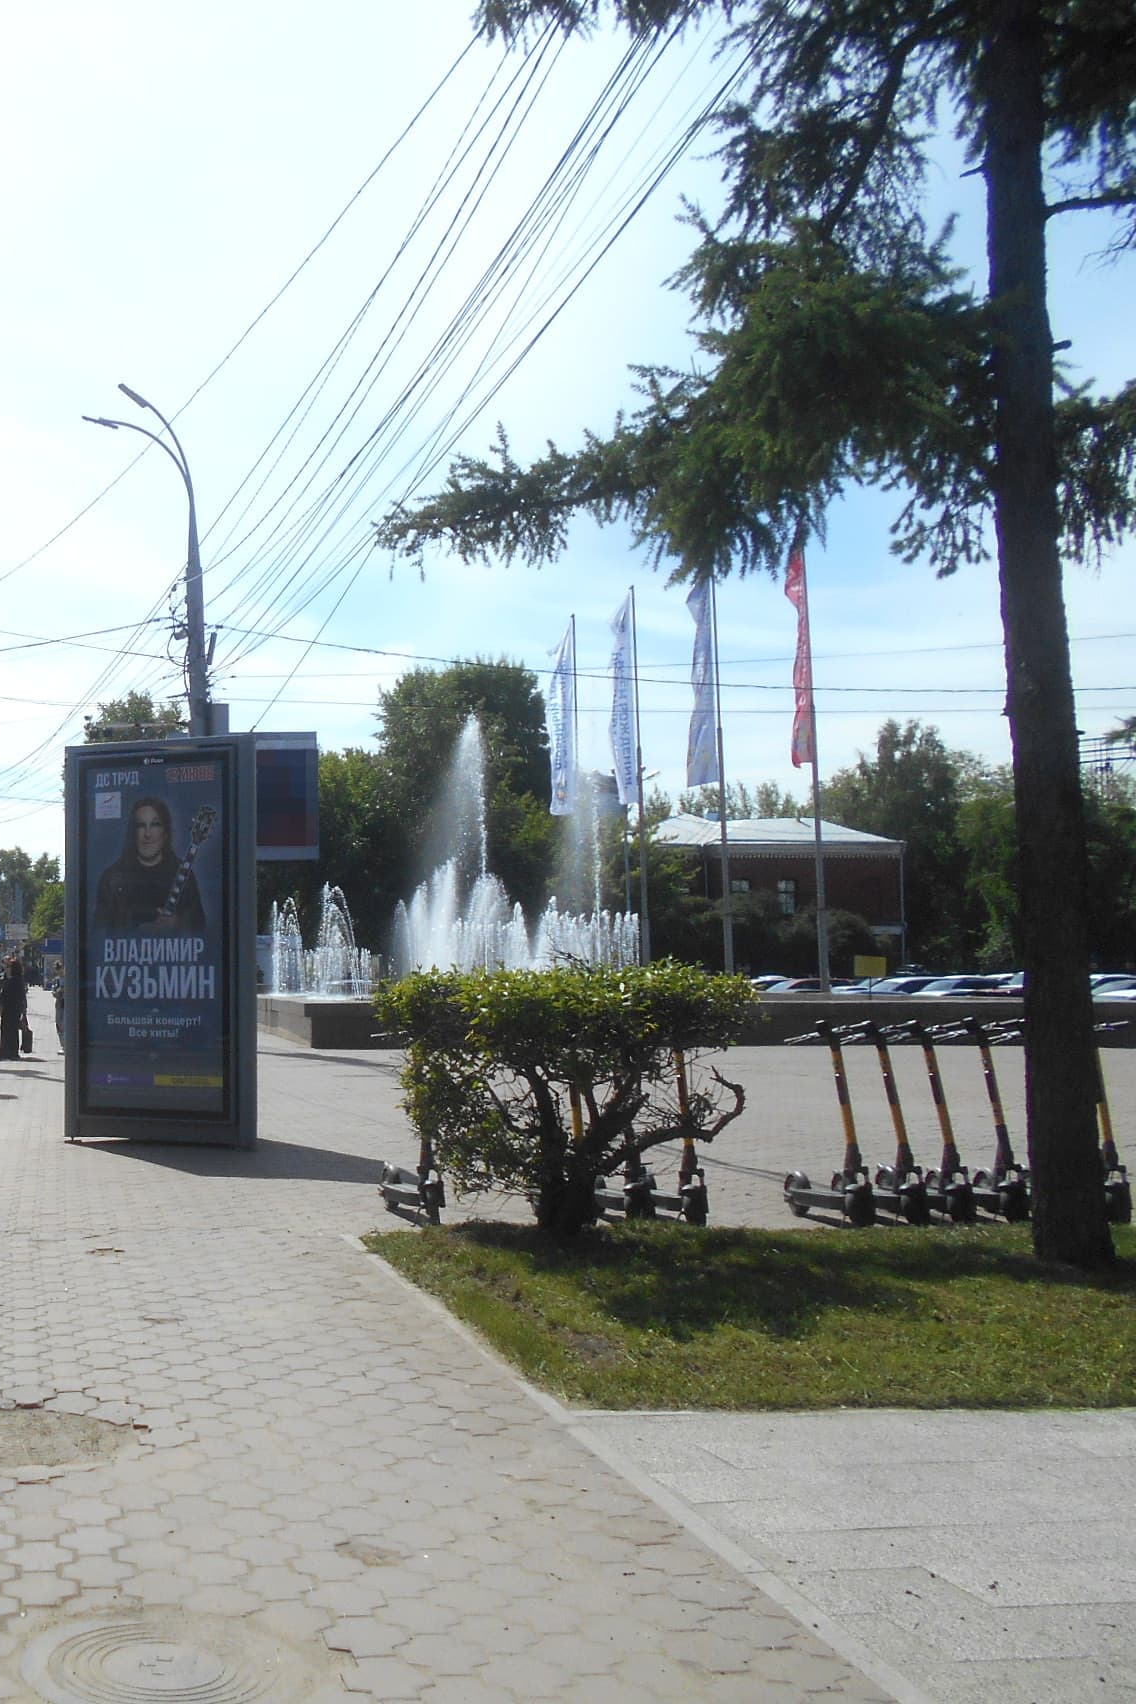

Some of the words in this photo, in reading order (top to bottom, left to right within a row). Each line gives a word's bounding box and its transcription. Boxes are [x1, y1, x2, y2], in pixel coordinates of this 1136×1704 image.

[95, 773, 110, 788] ДС
[111, 770, 140, 787] ТРУД
[103, 937, 205, 965] ВЛАДИМИР
[95, 965, 215, 999] КУЗЬМИН
[107, 1013, 153, 1025] Большой
[155, 1015, 201, 1028] концерт!
[128, 1026, 147, 1037] Все
[150, 1028, 179, 1038] хиты!
